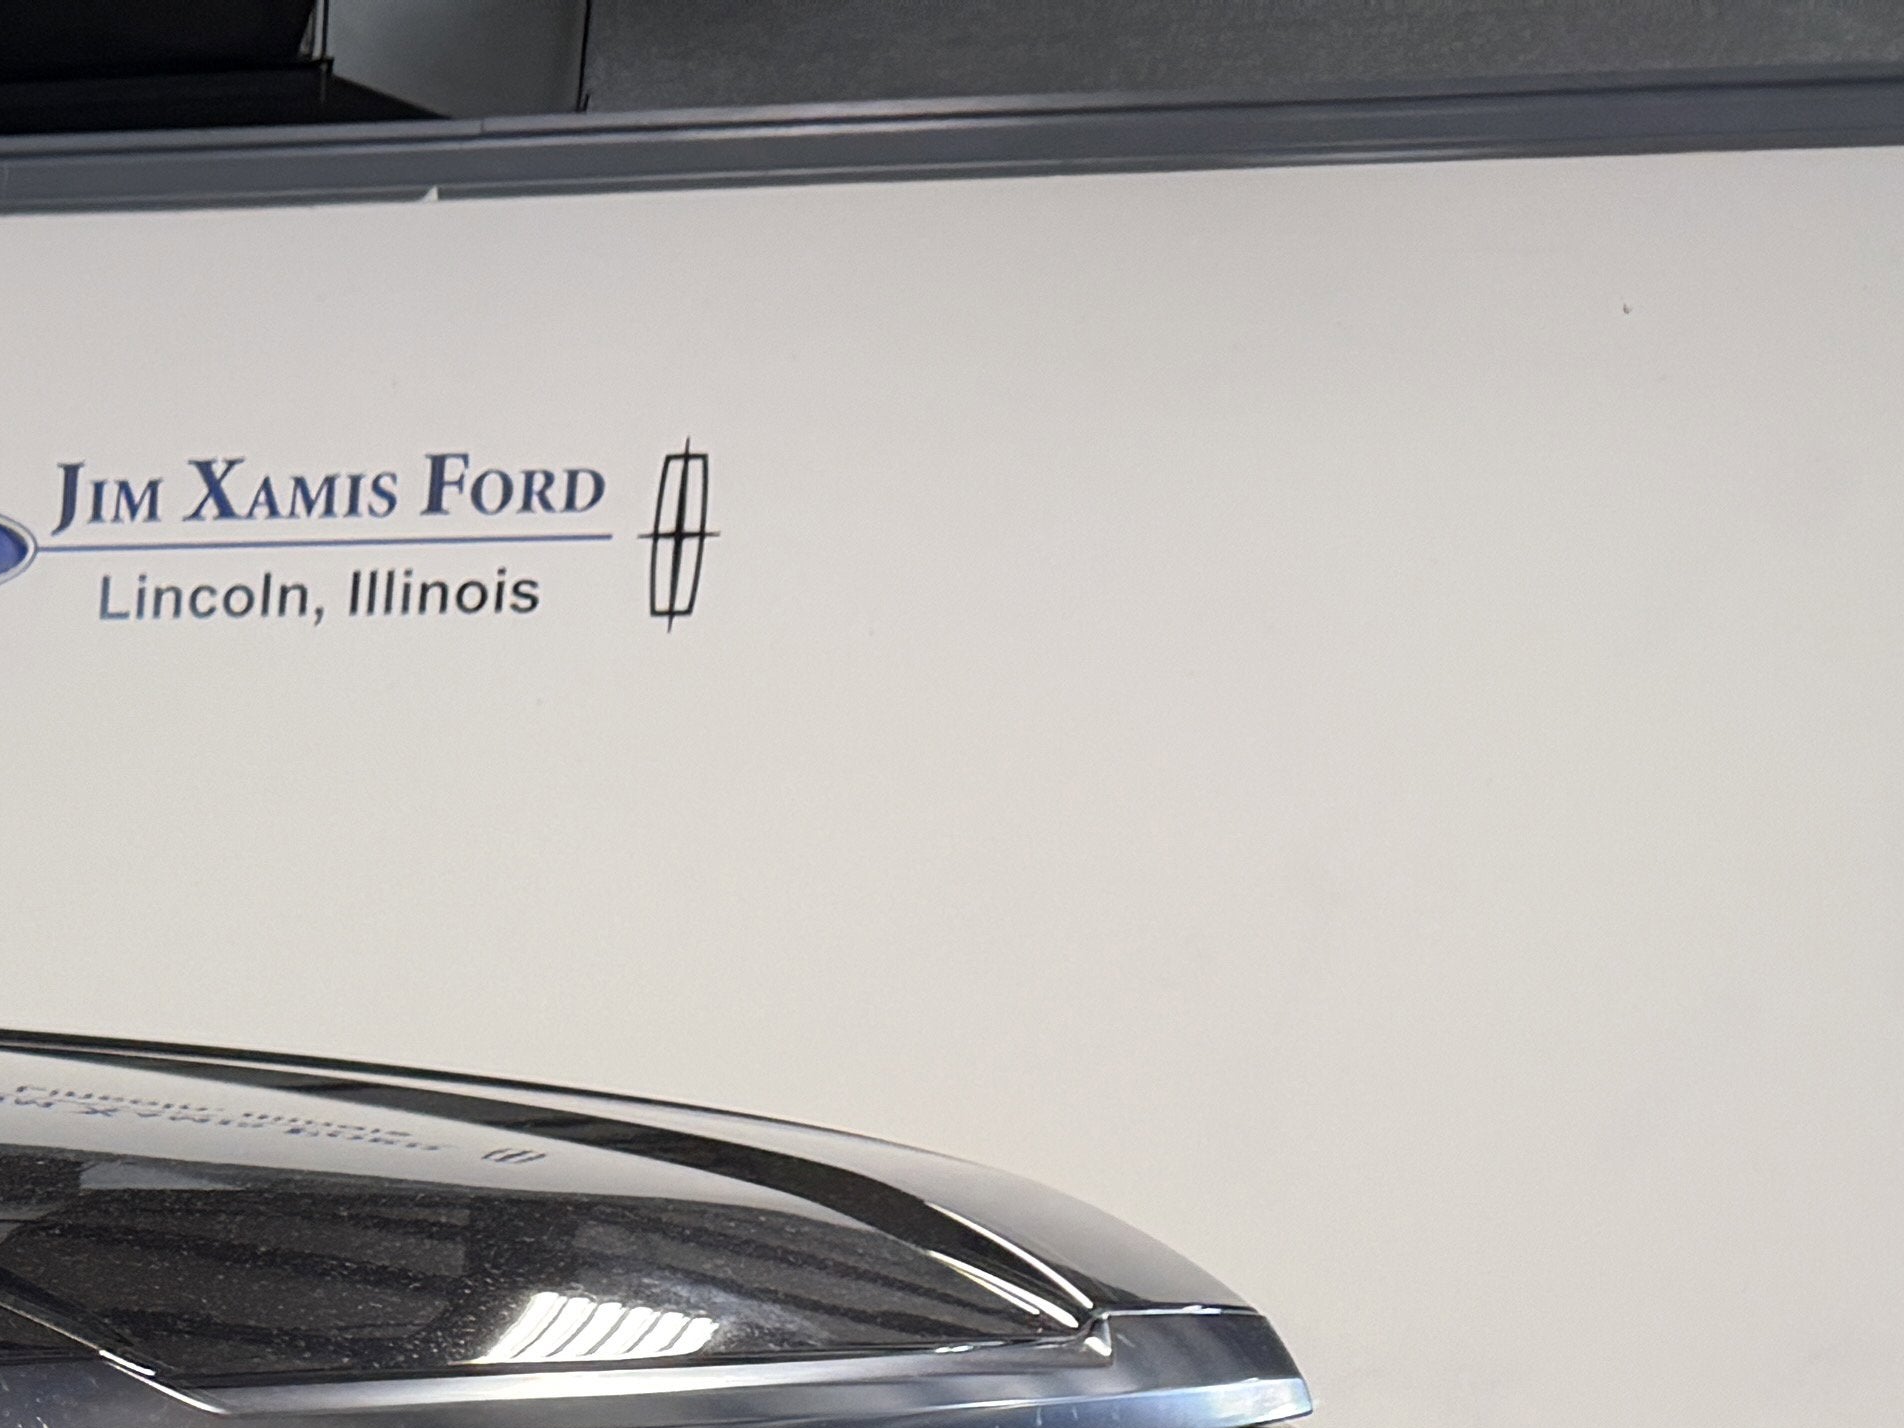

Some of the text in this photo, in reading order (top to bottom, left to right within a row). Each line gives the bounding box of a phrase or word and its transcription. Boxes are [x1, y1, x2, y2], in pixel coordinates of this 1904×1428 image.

[51, 453, 606, 536] JIM XAMIS FORD
[99, 567, 540, 626] Lincoln, Illinois
